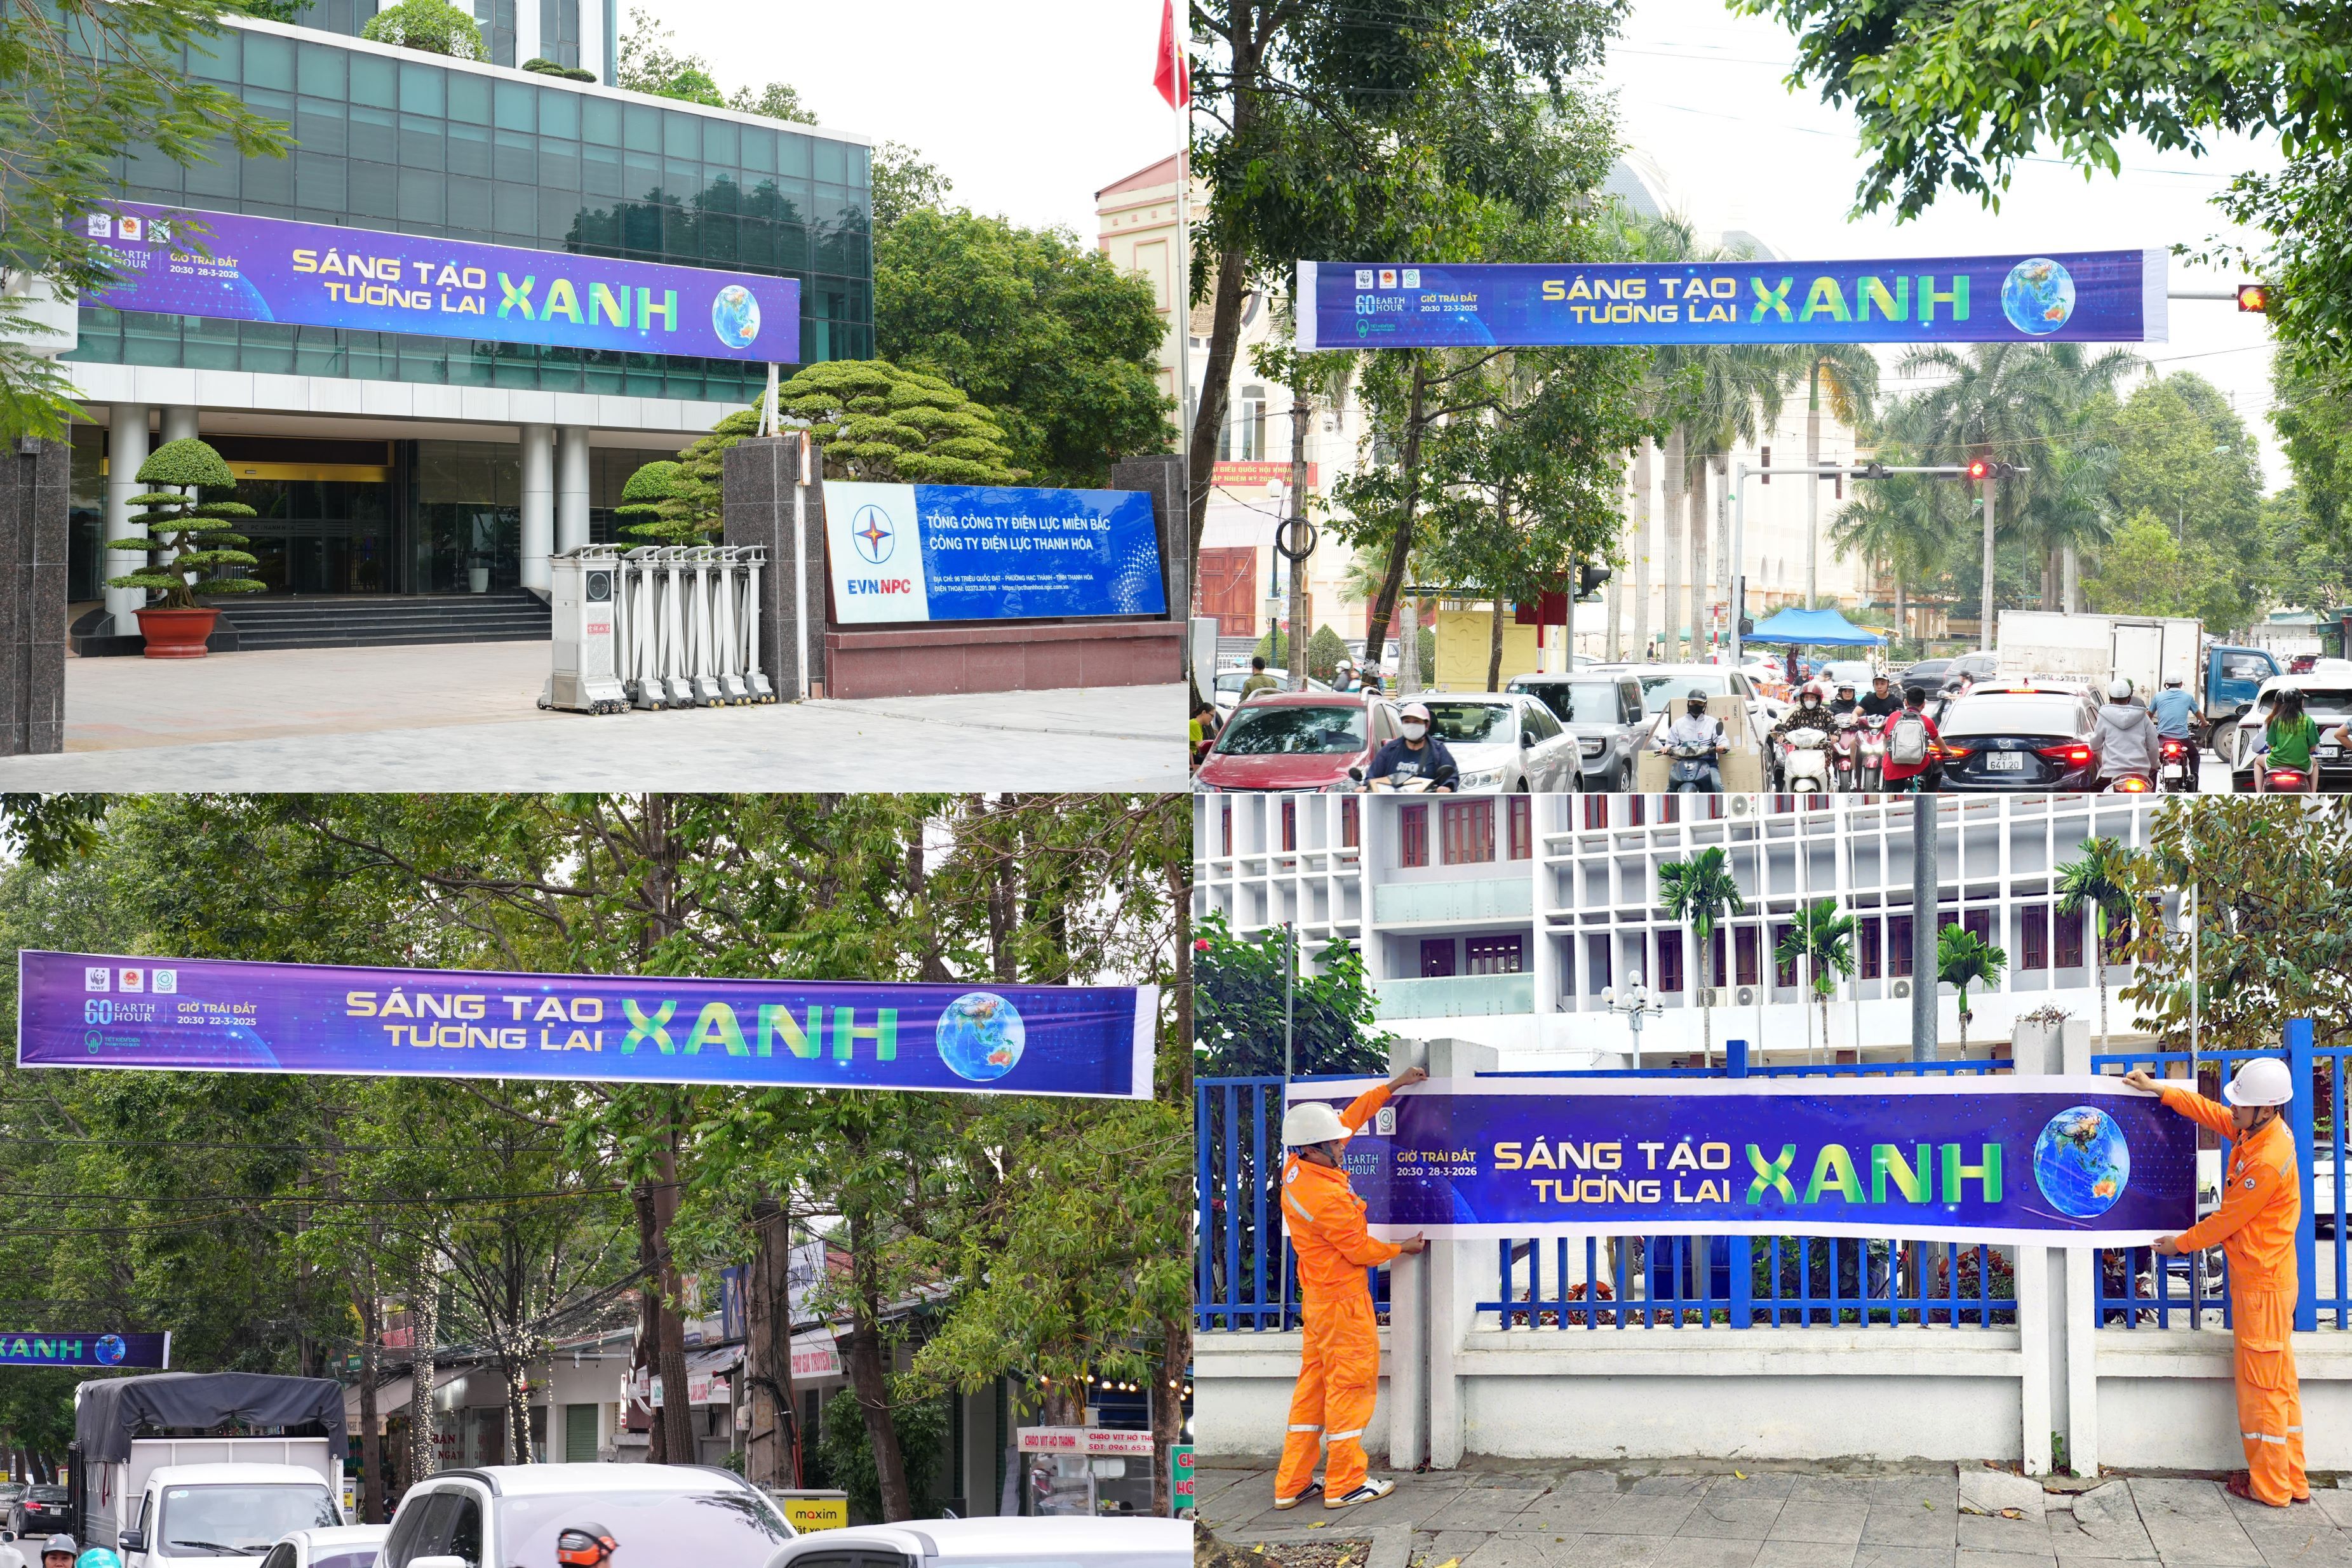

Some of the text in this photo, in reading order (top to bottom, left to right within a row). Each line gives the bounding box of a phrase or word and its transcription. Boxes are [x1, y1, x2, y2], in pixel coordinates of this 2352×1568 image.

[114, 249, 151, 260] EARTH
[218, 255, 239, 267] ĐẤT
[170, 265, 239, 278] 20:30 28-3-2026
[293, 247, 486, 292] SÁNG TẠO
[1542, 274, 1736, 304] SÁNG TẠO
[325, 281, 485, 314] TƯƠNG LAI
[497, 272, 677, 332] XANH
[1421, 291, 1477, 302] GIỜ TRÁI ĐẤT
[1750, 276, 1970, 323] XANH
[1355, 295, 1375, 315] 60
[1570, 301, 1736, 323] TƯƠNG LAI
[1239, 464, 1256, 473] QUỐC
[926, 509, 1110, 532] TỔNG CÔNG TY ĐIỆN LỰC MIỀN BẮC
[929, 534, 1093, 553] CÔNG TY ĐIỆN LỰC THANH HÓA
[847, 579, 911, 594] EVNNPC
[1997, 752, 2012, 761] 36A
[84, 999, 112, 1024] 60
[114, 1003, 155, 1013] EARTH
[177, 1001, 257, 1014] GIỜ TRÁI ĐẤT
[346, 986, 603, 1028] SÁNG TẠO
[114, 1012, 152, 1022] HOUR
[177, 1016, 257, 1026] 20:30 22-3-2025
[384, 1021, 602, 1052] TƯƠNG LAI
[620, 999, 897, 1061] XANH
[1348, 1154, 1379, 1164] EARTH
[1397, 1148, 1476, 1162] GIỜ TRÁI ĐẤT
[1494, 1135, 1730, 1177] SÁNG TẠO
[1348, 1165, 1377, 1175] HOUR
[1397, 1167, 1477, 1176] 20:30 28-3-2026
[1745, 1144, 2002, 1204] XANH
[1531, 1174, 1730, 1203] TƯƠNG LAI
[1025, 1433, 1038, 1446] CHÁO
[1178, 1453, 1194, 1467] CH
[796, 1508, 837, 1519] maxim
